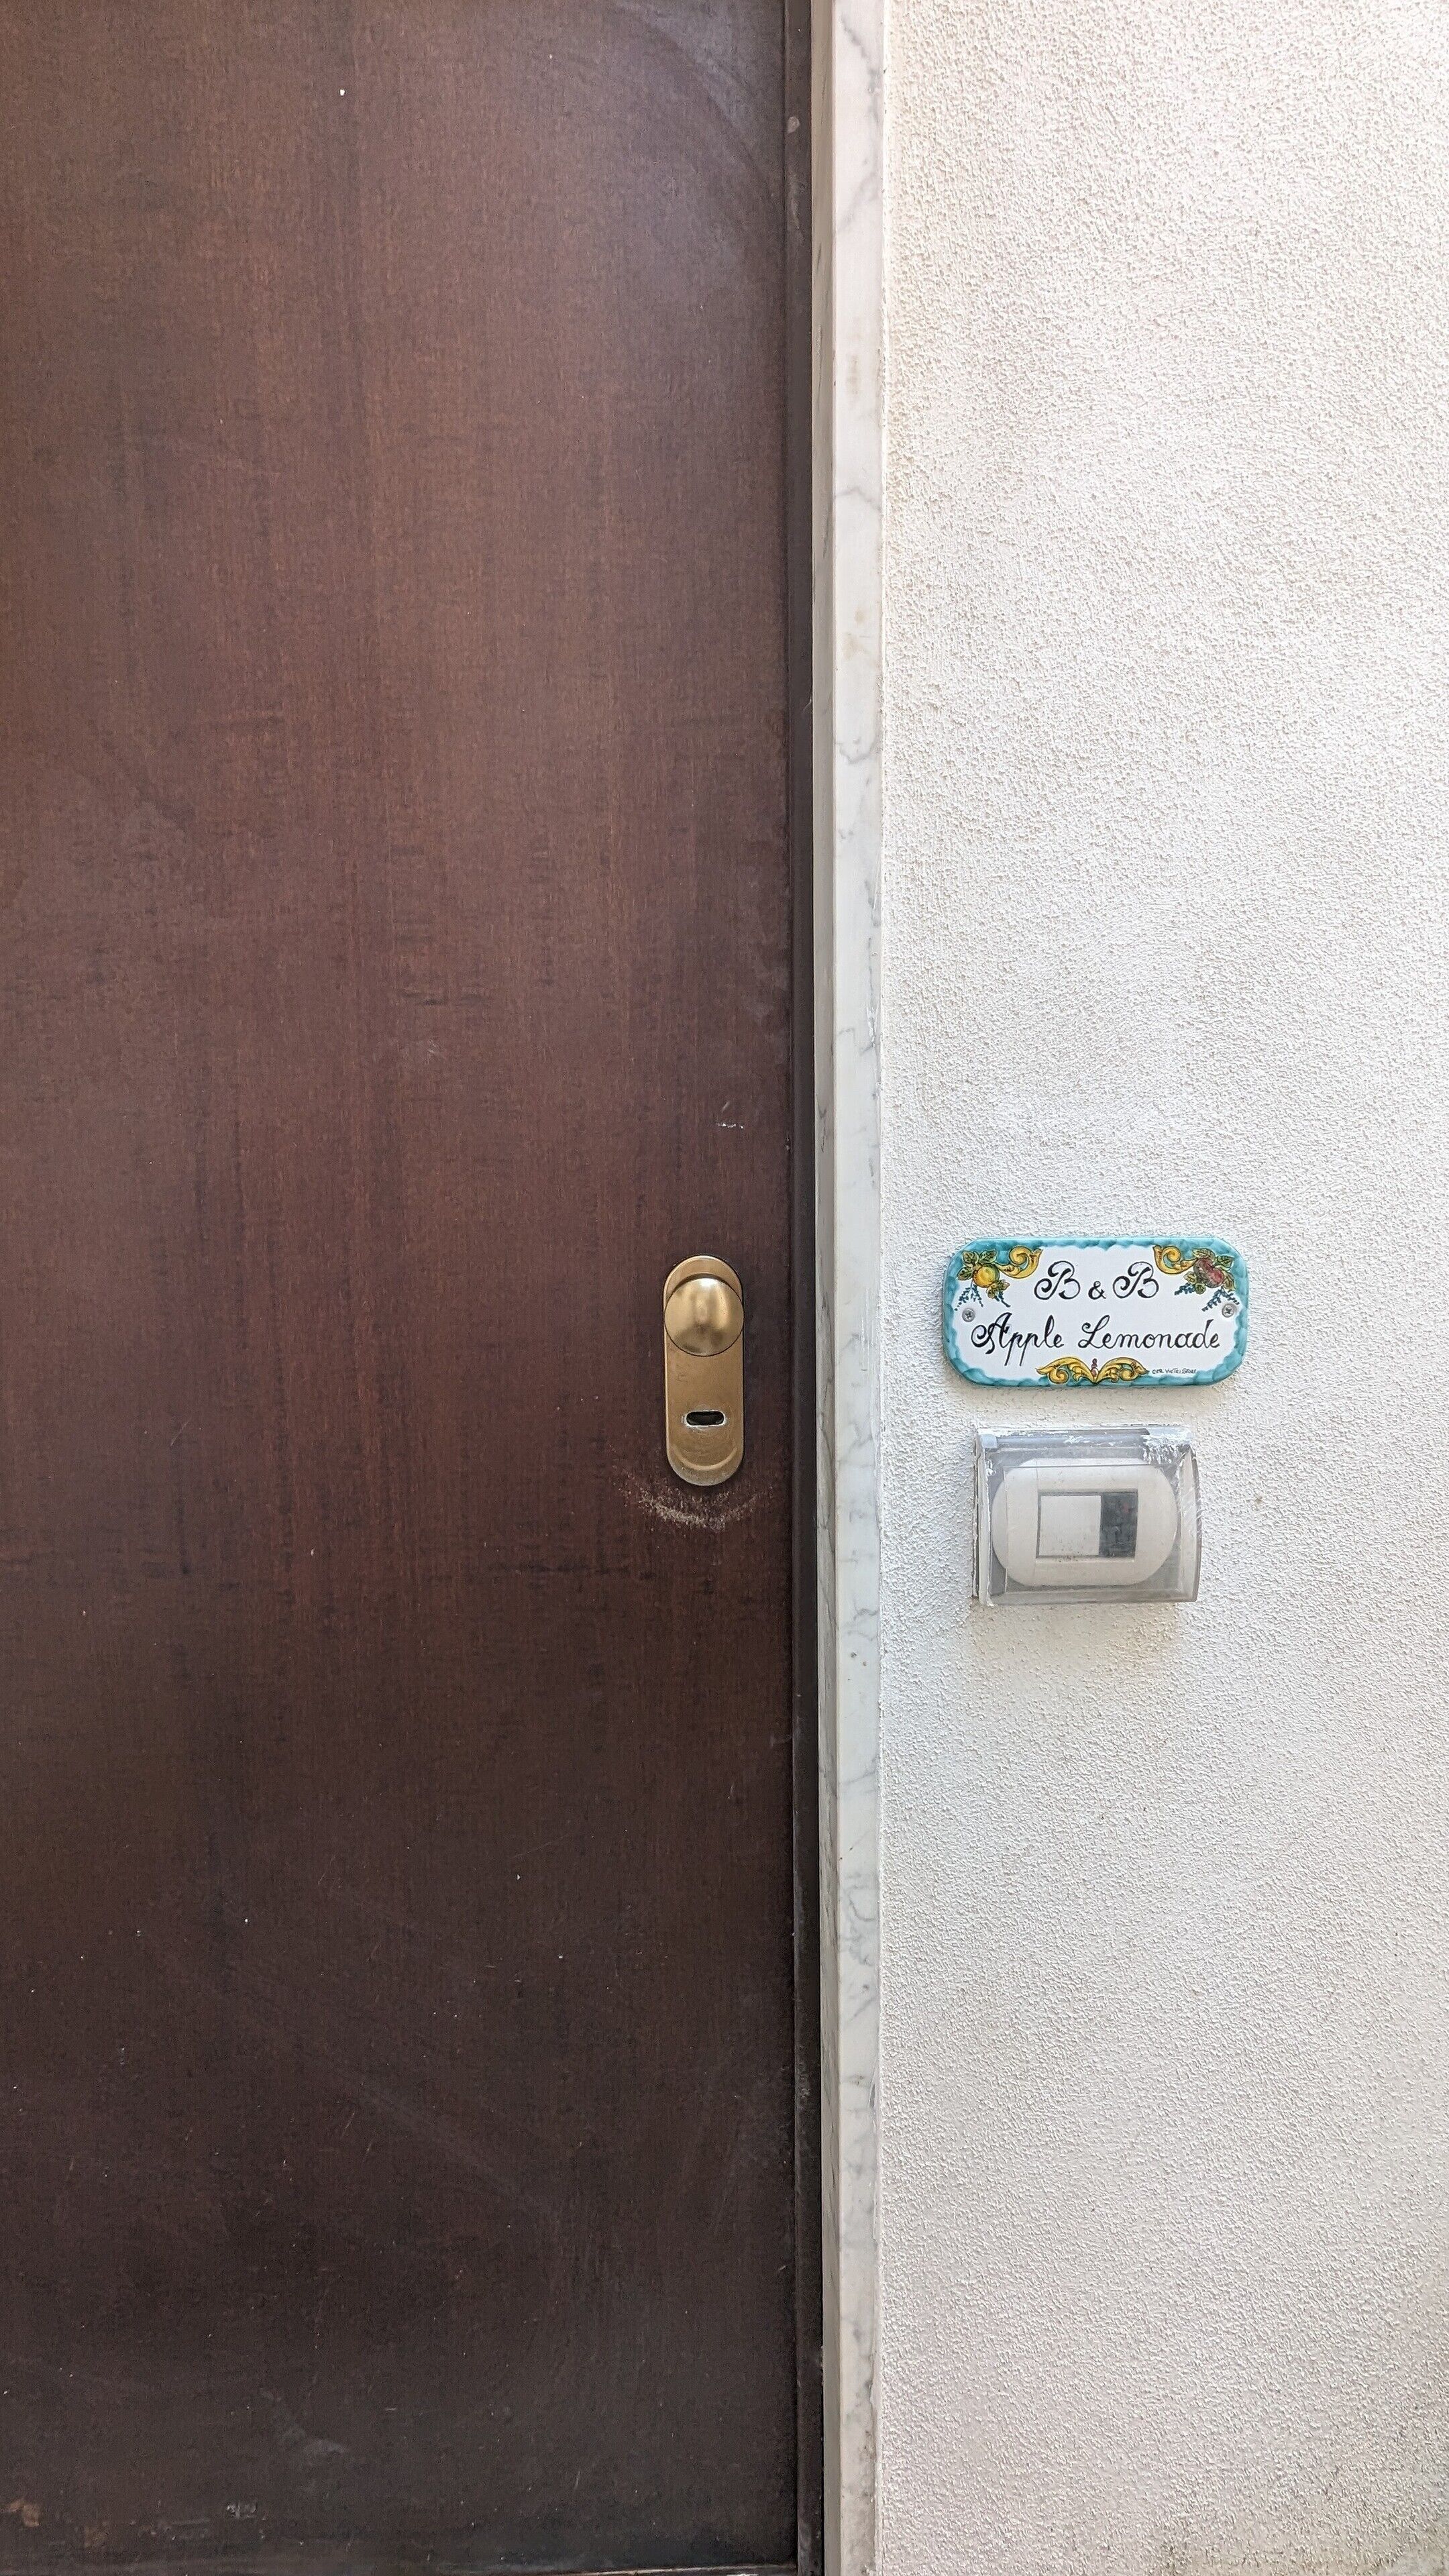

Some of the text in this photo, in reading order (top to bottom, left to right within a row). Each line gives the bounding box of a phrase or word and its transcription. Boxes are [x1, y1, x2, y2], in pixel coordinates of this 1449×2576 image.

[1034, 1260, 1159, 1300] B & B
[971, 1312, 1220, 1366] Apple Lemonade
